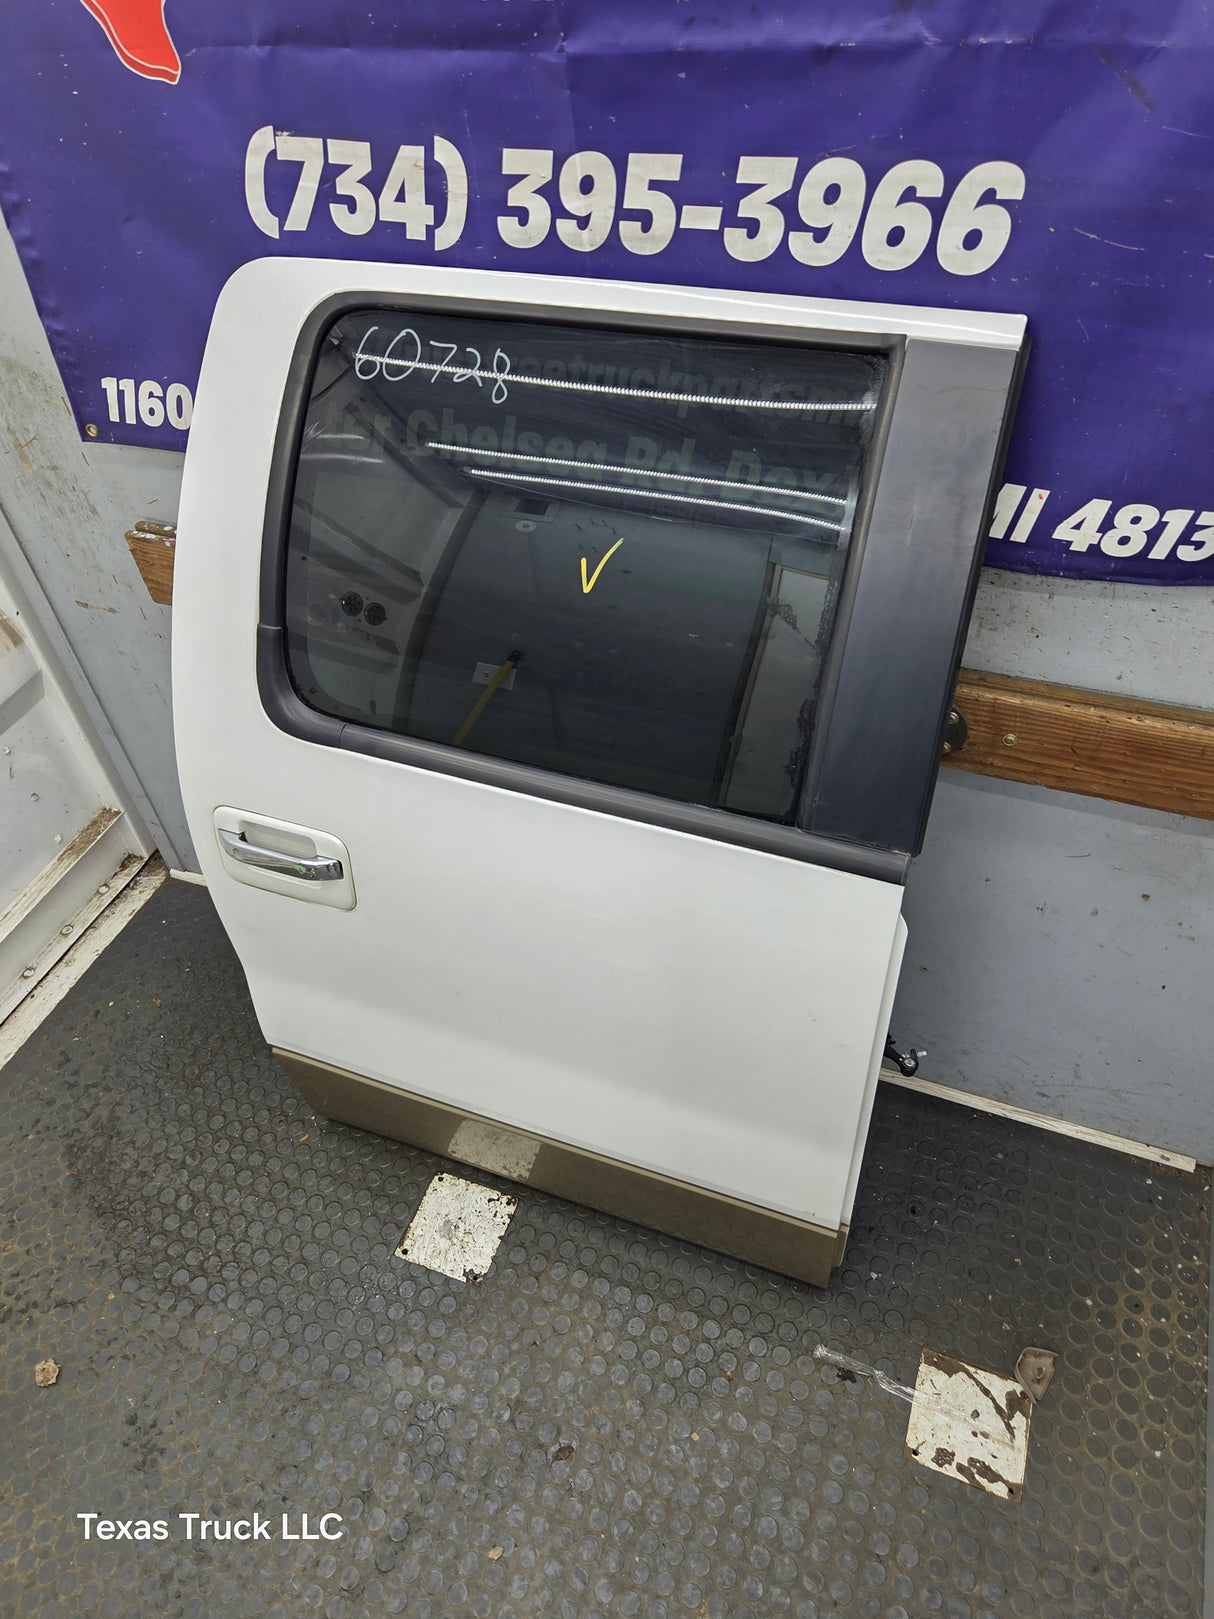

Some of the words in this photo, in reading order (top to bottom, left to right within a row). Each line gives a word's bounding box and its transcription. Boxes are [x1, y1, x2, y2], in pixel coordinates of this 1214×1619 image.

[244, 125, 469, 252] (734)
[497, 148, 1026, 276] 395-3966
[100, 376, 193, 430] 1160
[355, 325, 512, 404] 60728
